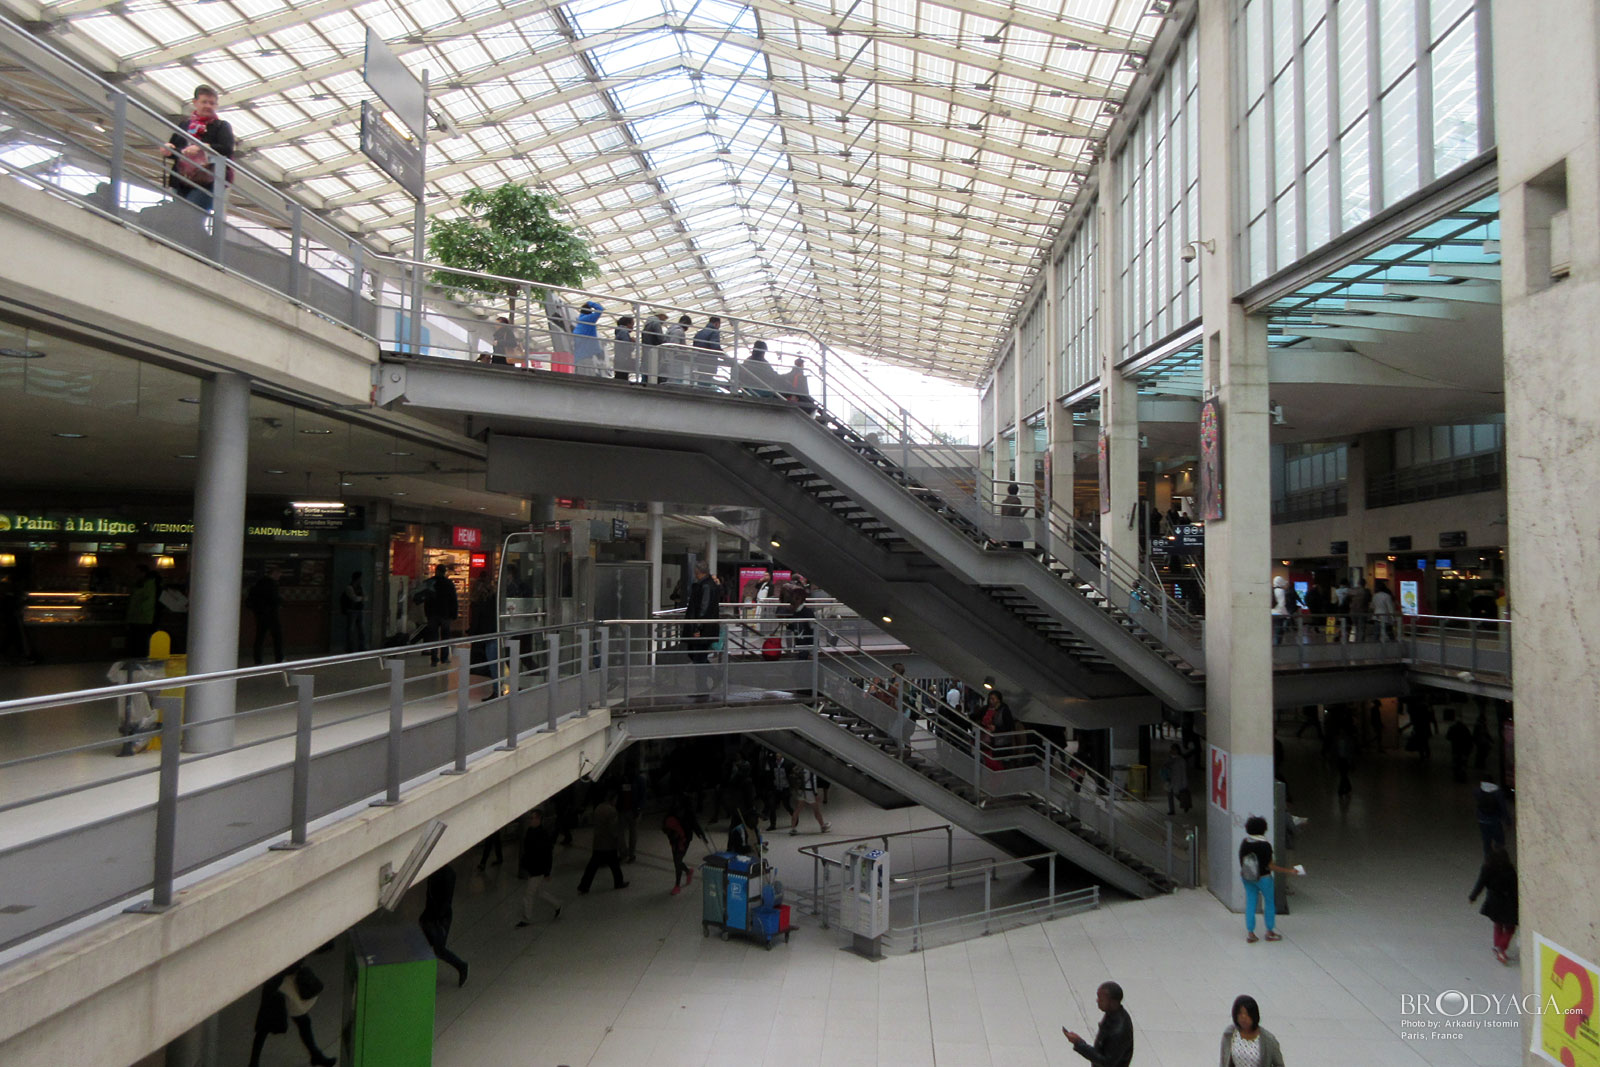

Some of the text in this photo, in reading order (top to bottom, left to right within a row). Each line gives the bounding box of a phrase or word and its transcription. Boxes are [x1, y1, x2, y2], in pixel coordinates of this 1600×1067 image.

[15, 515, 62, 531] Pains
[65, 517, 75, 531] à
[79, 518, 94, 532] la
[248, 526, 310, 537] SANDWICHES
[458, 528, 476, 542] HEMA
